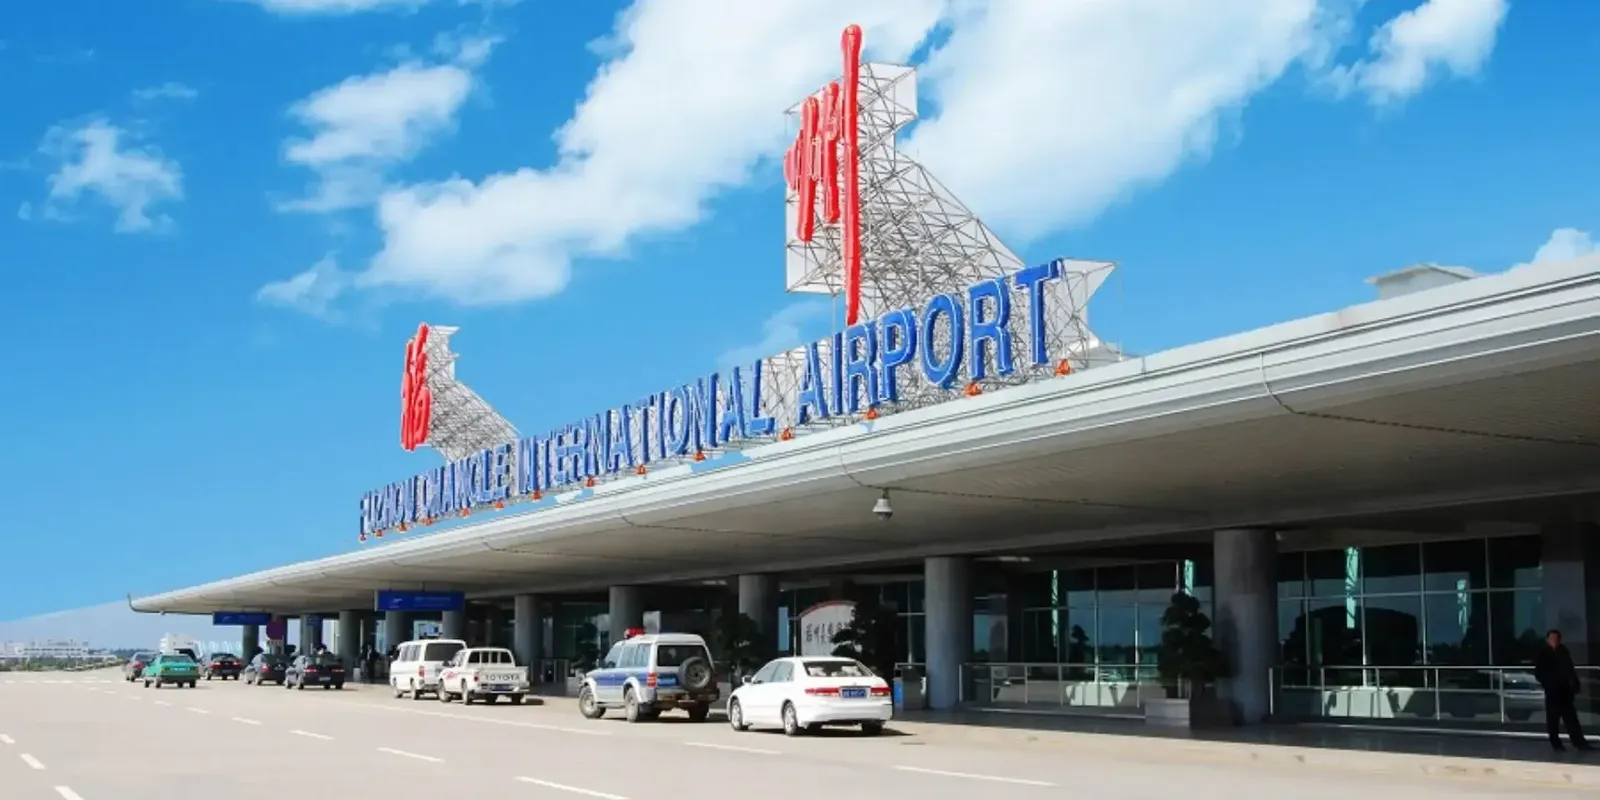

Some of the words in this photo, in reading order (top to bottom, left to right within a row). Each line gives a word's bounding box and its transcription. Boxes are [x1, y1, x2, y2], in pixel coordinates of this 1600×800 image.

[516, 360, 776, 495] INTERNATIONAL
[799, 258, 1063, 424] AIRPORT
[485, 673, 520, 681] TOYOTA
